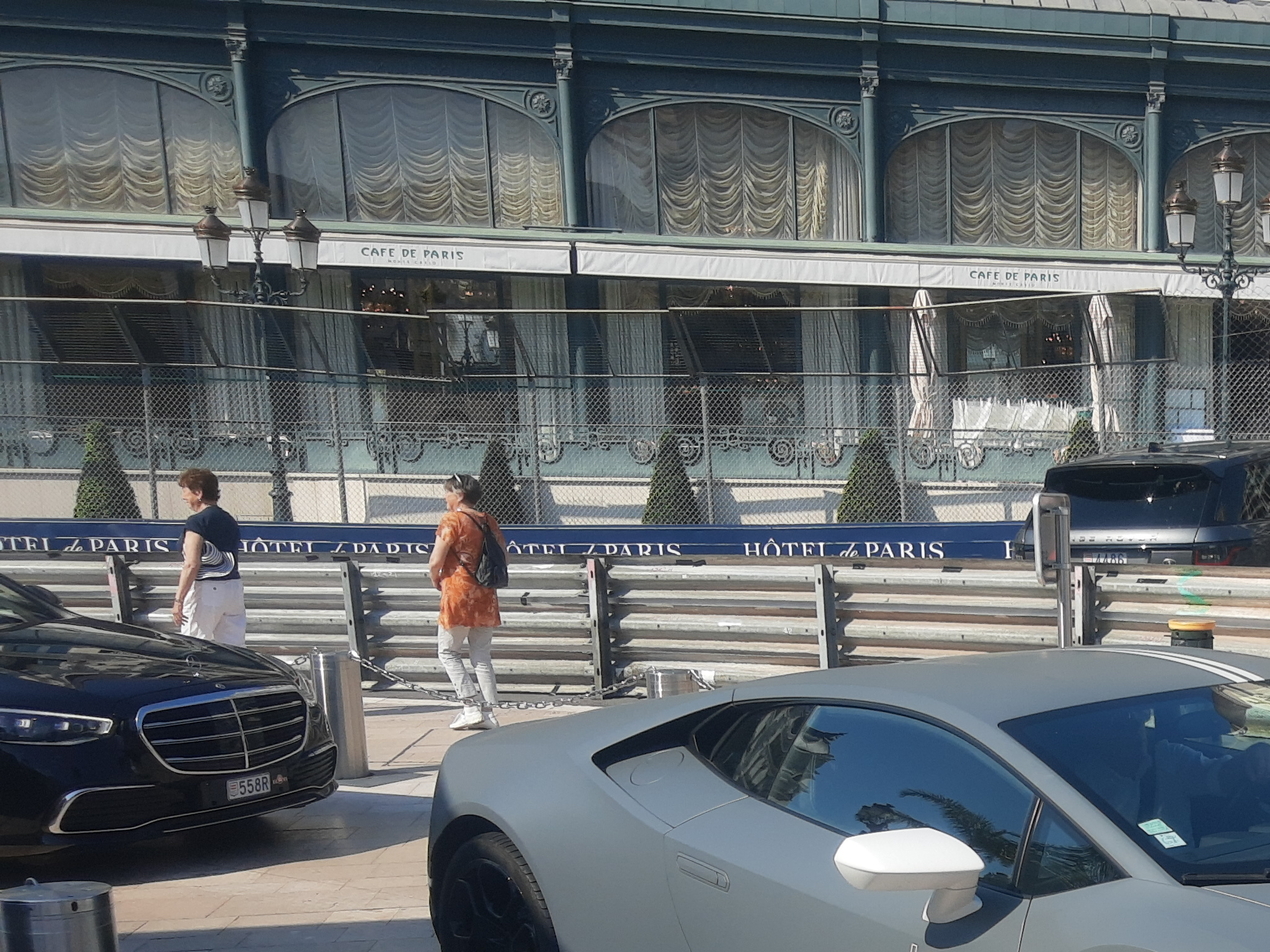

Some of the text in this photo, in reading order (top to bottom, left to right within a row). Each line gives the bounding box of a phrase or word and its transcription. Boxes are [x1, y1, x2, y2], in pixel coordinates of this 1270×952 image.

[361, 247, 464, 260] CAFE DE PARIS
[969, 270, 1060, 282] CAFE DE PARIS
[90, 538, 169, 552] PARIS
[743, 537, 829, 557] HÔTEL
[865, 541, 944, 558] PARIS
[239, 776, 269, 795] 558R
